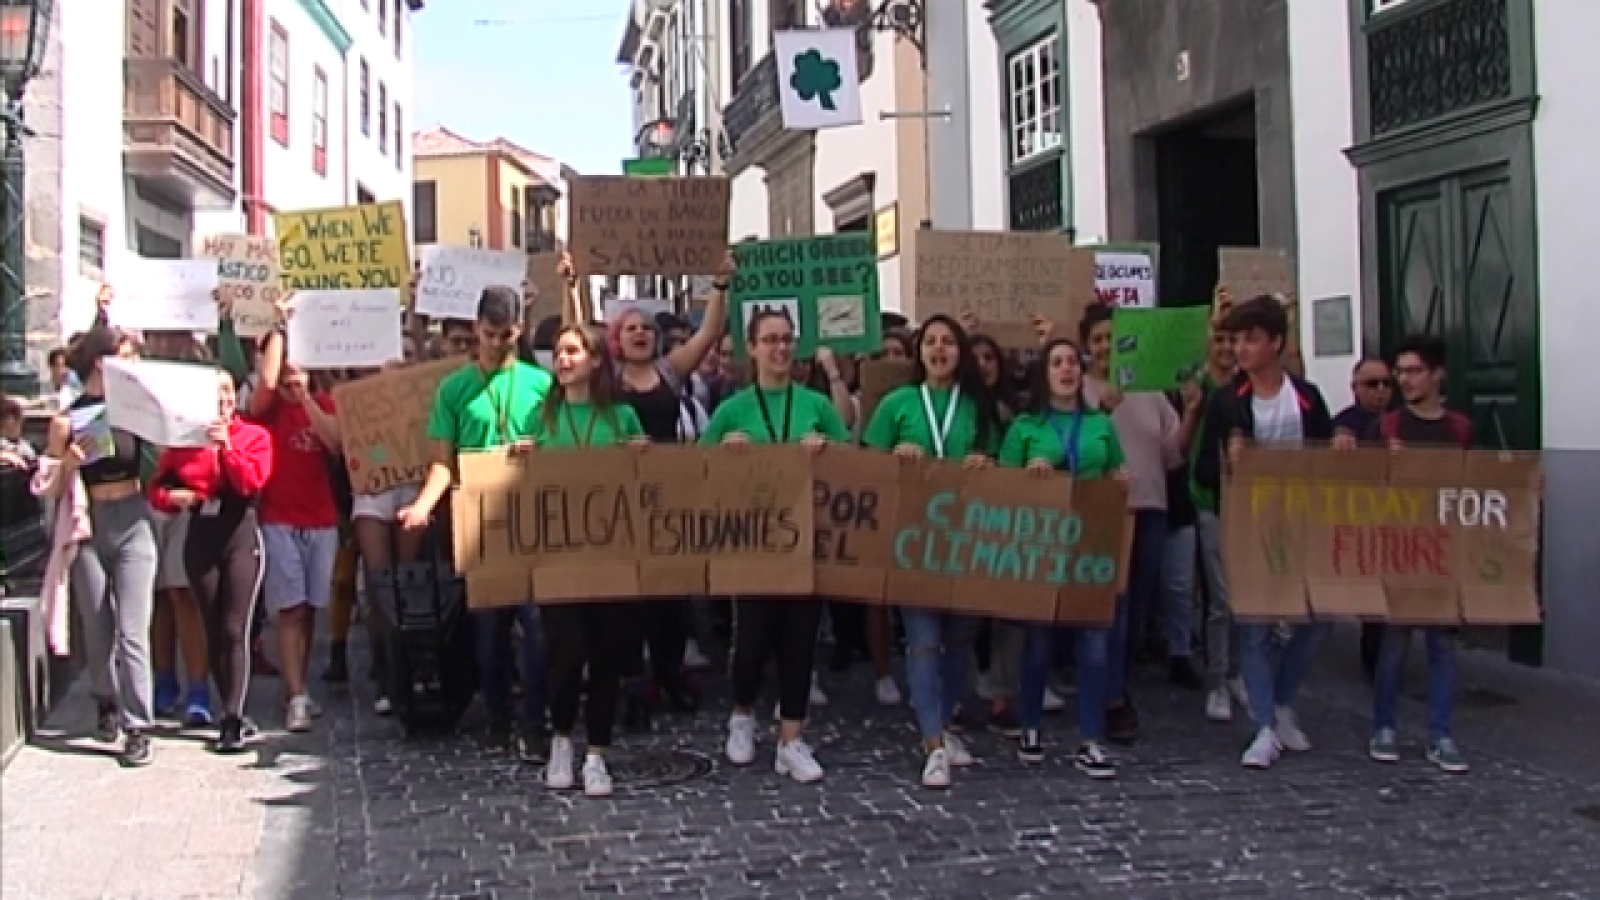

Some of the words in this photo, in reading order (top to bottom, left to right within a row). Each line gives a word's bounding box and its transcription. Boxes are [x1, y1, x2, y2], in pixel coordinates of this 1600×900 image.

[302, 213, 353, 239] WHEN
[360, 205, 393, 236] WE
[579, 204, 632, 223] FUERA
[669, 201, 720, 221] BANCO
[279, 243, 316, 270] GO,
[589, 244, 713, 268] SALVADO
[733, 243, 804, 268] WHICH
[810, 238, 872, 261] GREEN
[919, 254, 1067, 279] MEDIOAMBIENTE
[278, 271, 350, 289] TAKING
[357, 265, 399, 289] YOU
[734, 272, 761, 293] DO
[764, 268, 804, 289] YOU
[812, 262, 871, 293] SEE?
[812, 480, 879, 531] POR
[1250, 476, 1424, 526] FRIDAY
[1437, 487, 1508, 529] FOR
[478, 484, 636, 565] HUELGA
[639, 481, 663, 508] DE
[649, 498, 801, 556] ESTUDIANTES
[813, 529, 858, 566] EL
[1332, 525, 1451, 576] FUTURE
